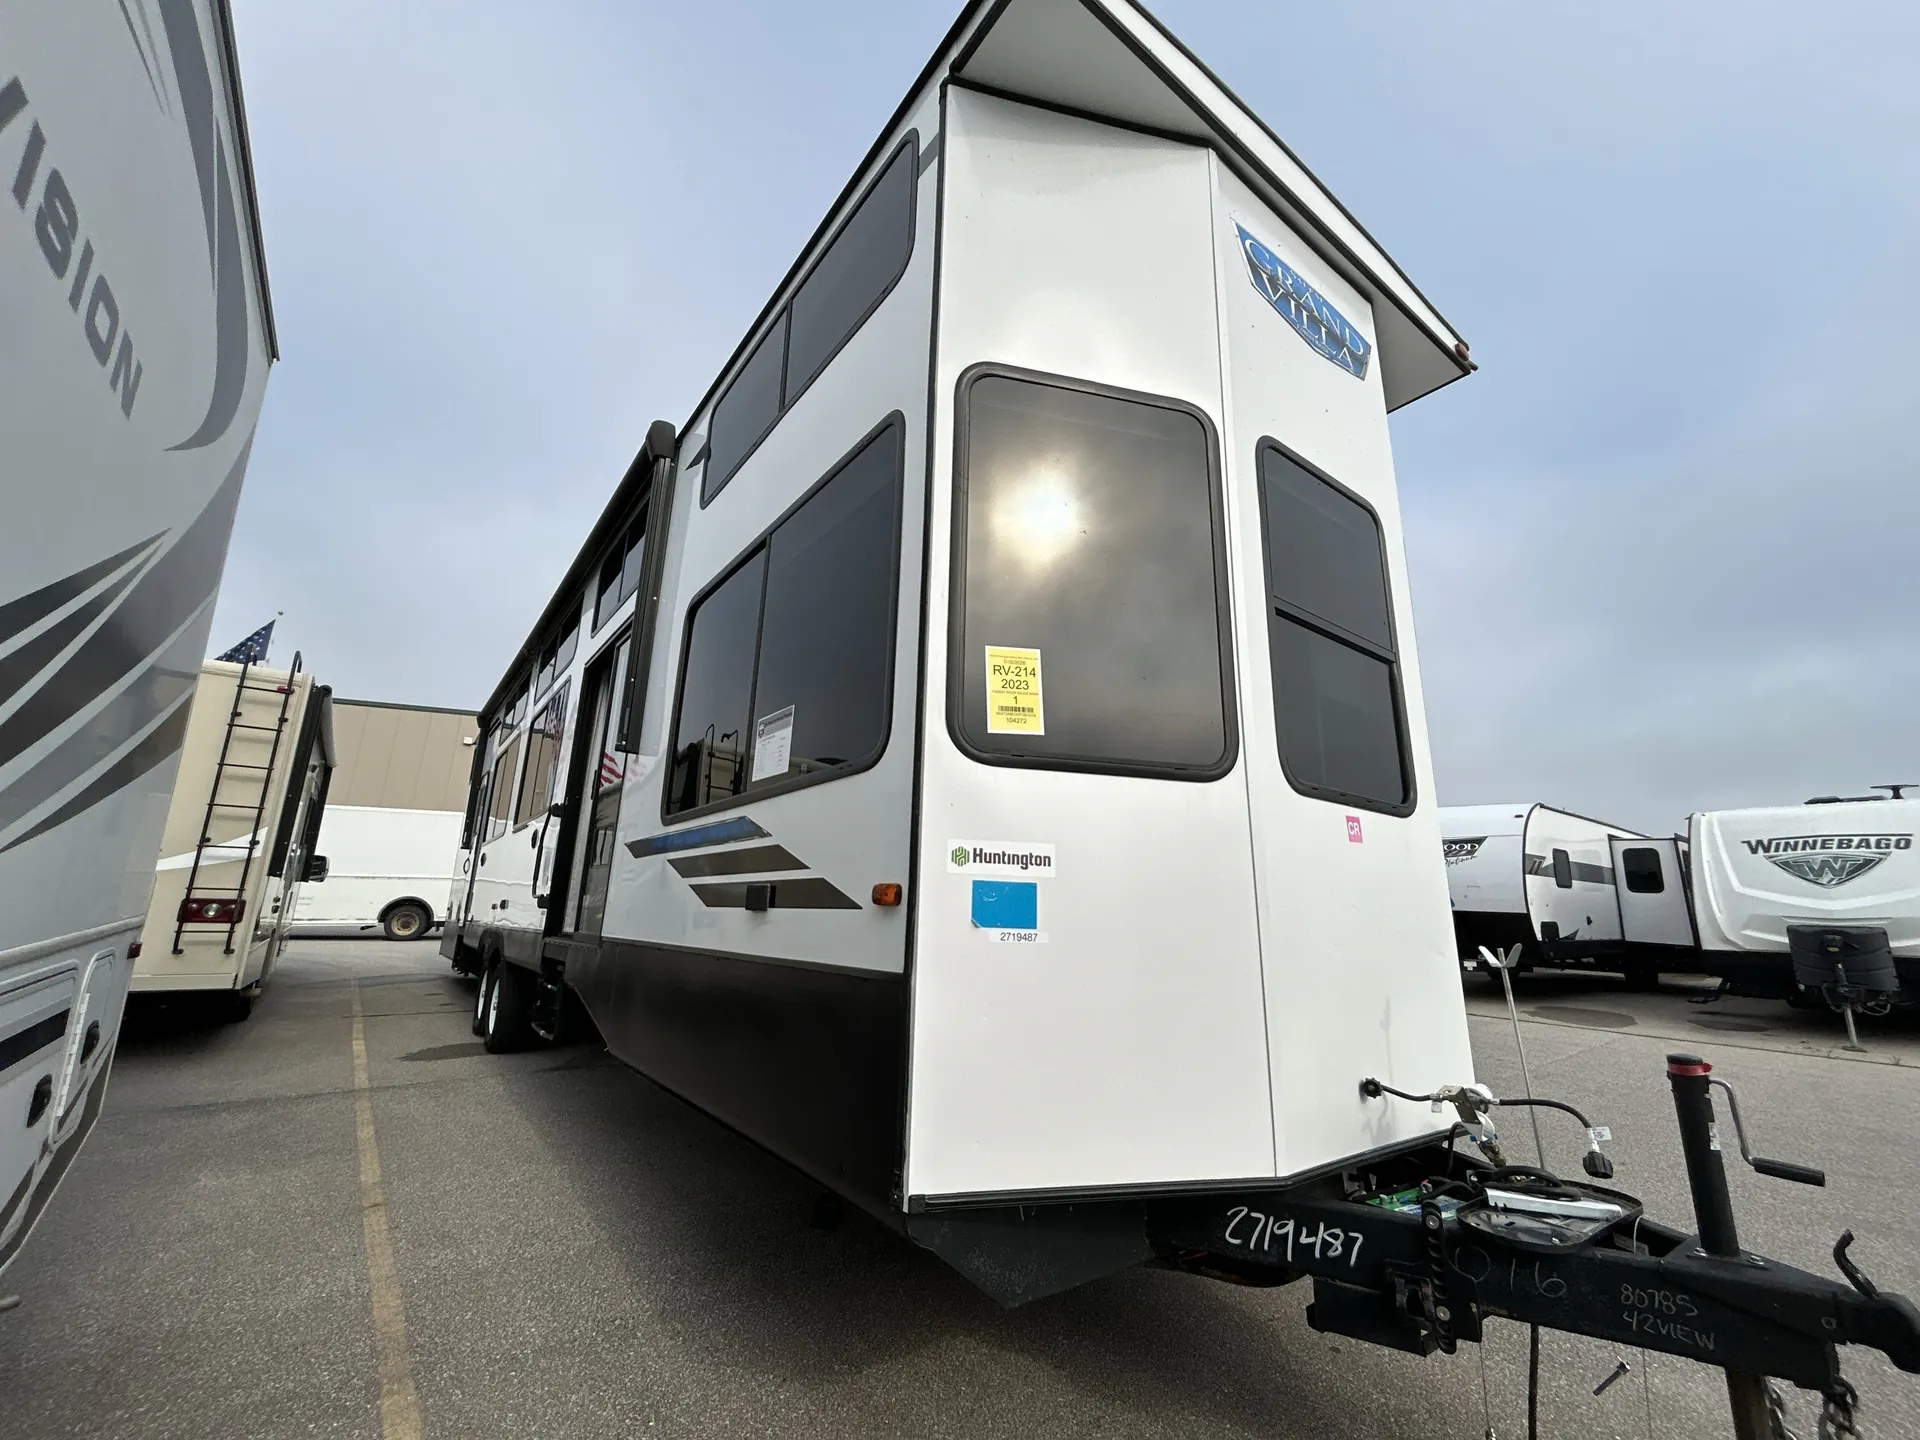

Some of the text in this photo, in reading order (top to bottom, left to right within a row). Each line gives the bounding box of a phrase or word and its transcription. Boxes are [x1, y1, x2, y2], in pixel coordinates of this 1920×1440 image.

[1244, 238, 1364, 357] GRAND
[1257, 267, 1356, 371] VILLA
[993, 664, 1036, 678] RV-214
[1001, 678, 1029, 690] 2023
[1013, 696, 1018, 705] 1
[1348, 821, 1361, 836] CR
[1741, 834, 1913, 855] WINNEBAGO
[972, 847, 1052, 870] Huntington
[1000, 932, 1038, 942] 2719487
[1225, 1206, 1364, 1267] 2719487
